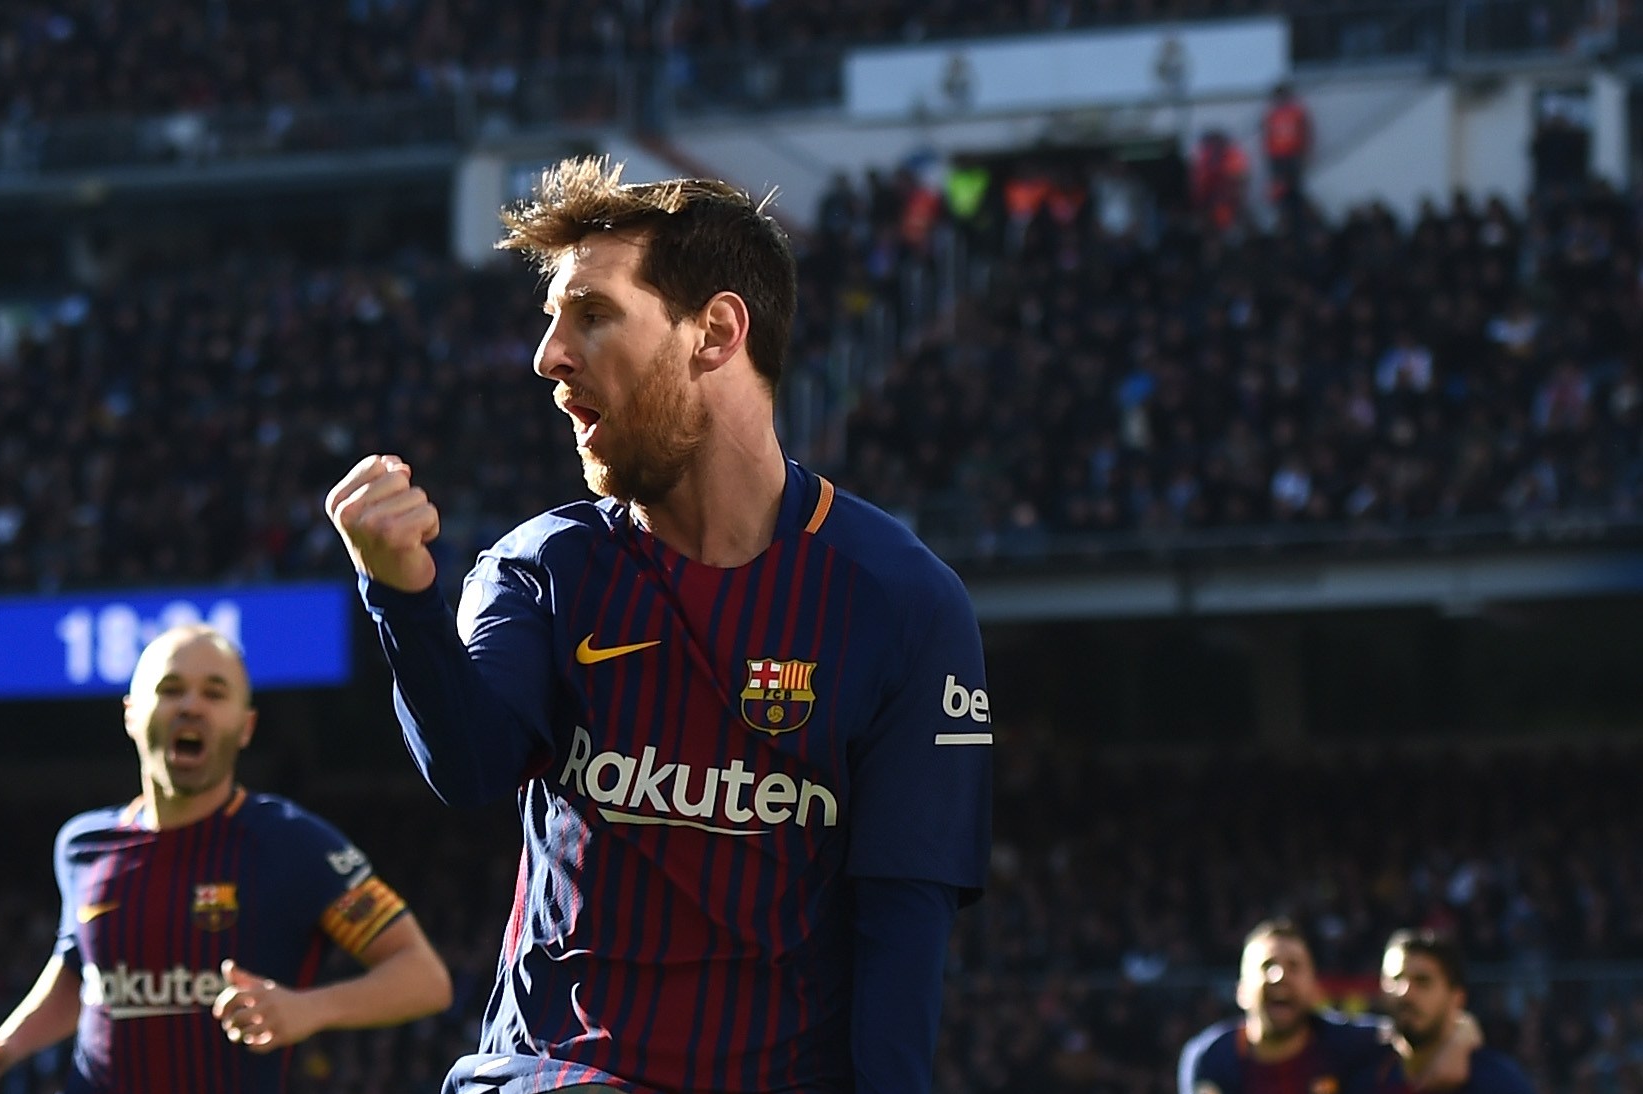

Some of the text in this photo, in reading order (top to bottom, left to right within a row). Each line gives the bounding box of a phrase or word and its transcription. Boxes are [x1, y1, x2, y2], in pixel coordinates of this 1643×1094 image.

[943, 674, 991, 723] be
[558, 725, 838, 828] Rakuten
[100, 962, 224, 1006] akute
